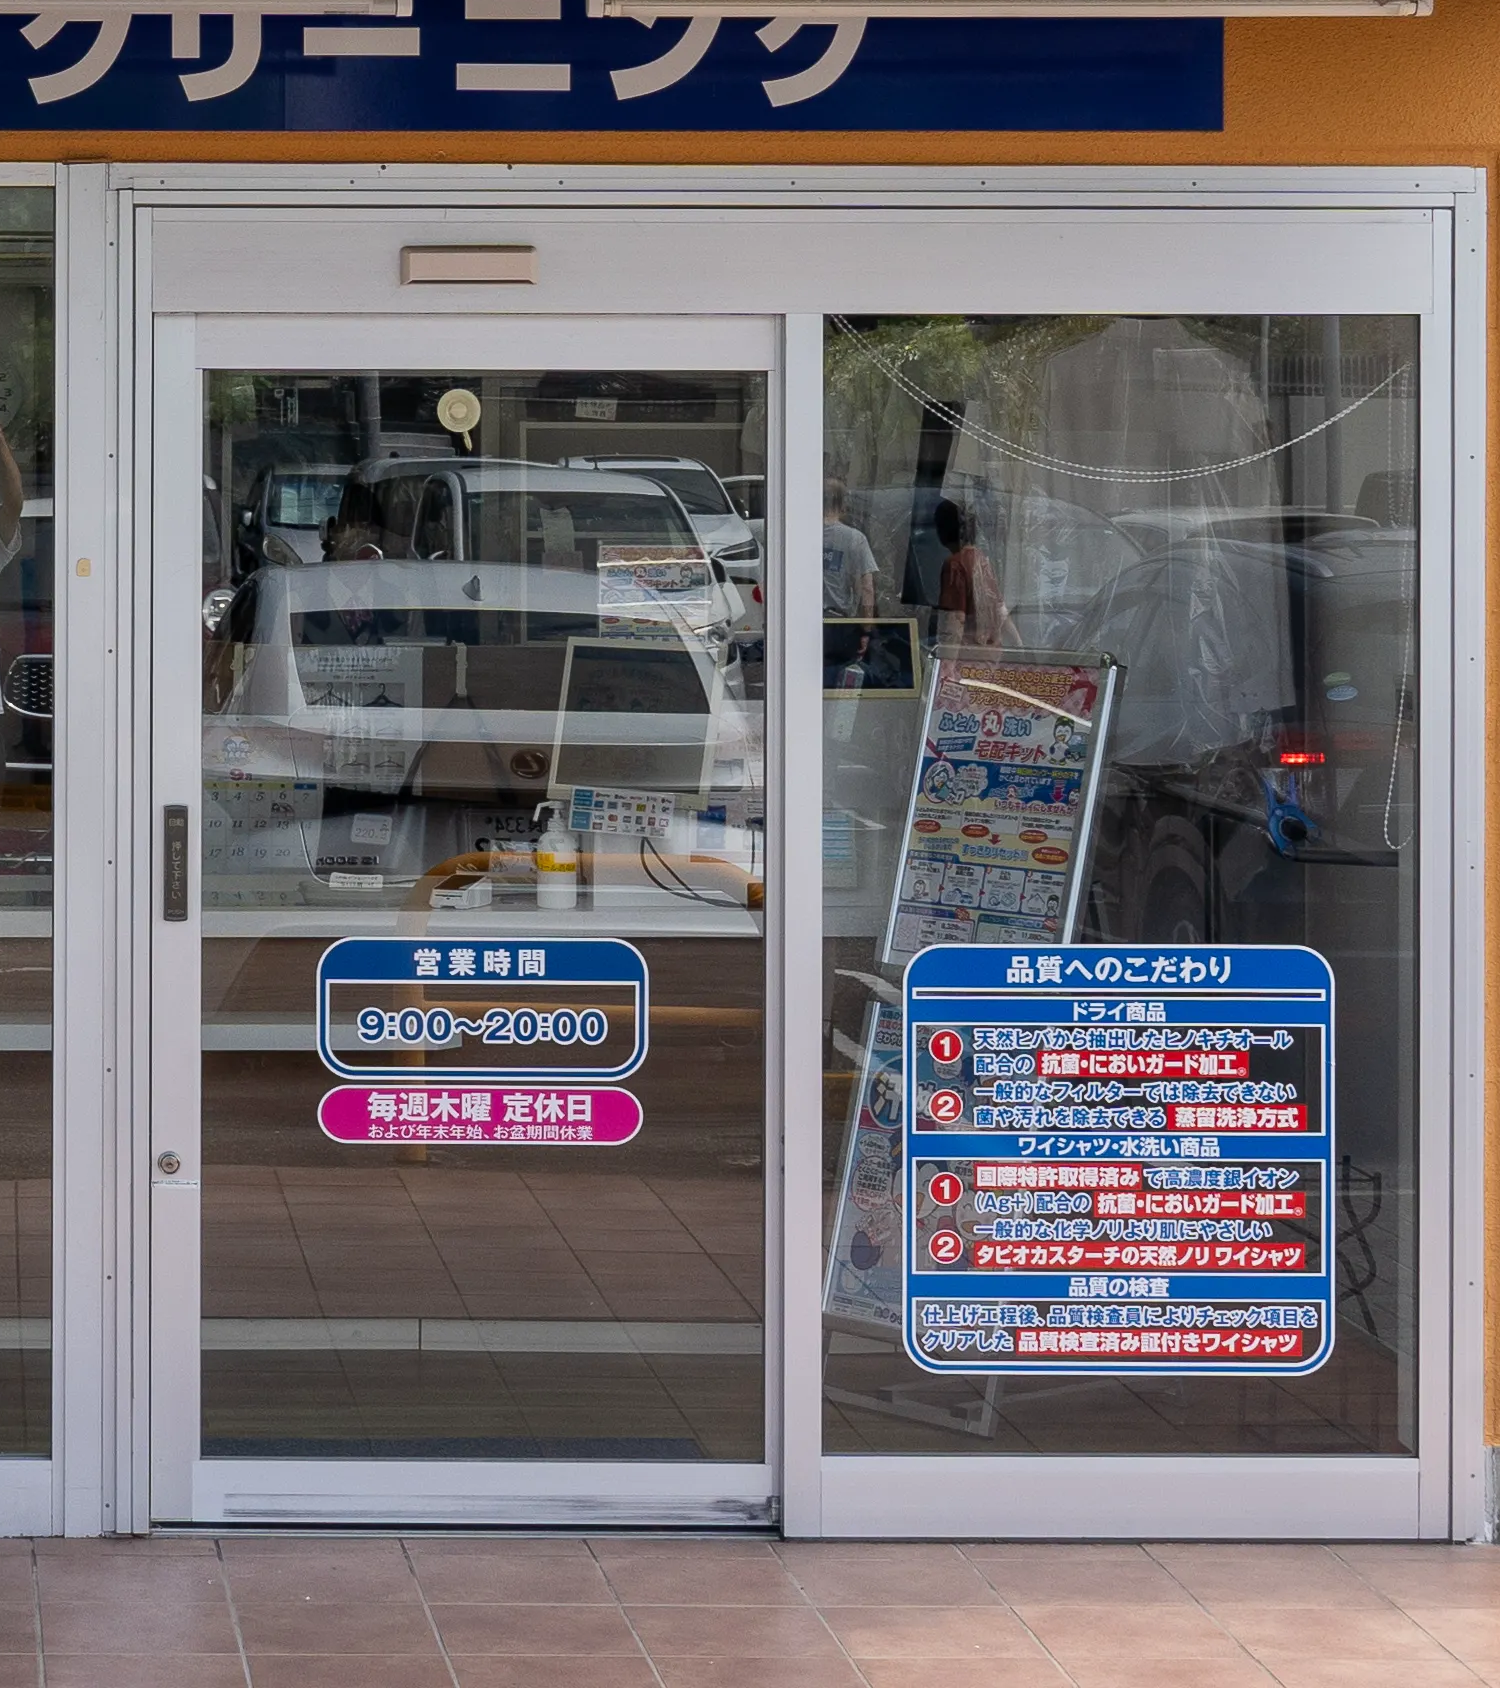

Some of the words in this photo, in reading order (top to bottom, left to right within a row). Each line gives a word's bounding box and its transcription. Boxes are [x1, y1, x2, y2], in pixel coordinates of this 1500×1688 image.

[974, 740, 1047, 762] 宅配キット
[413, 948, 546, 976] 営業時間
[1006, 955, 1232, 984] 品質へのこだわり
[1072, 1001, 1166, 1023] ドライ商品
[974, 1028, 1293, 1051] 天然ヒバから抽出したヒノキチオール
[974, 1054, 1034, 1076] 配合の
[974, 1082, 1297, 1103] 一般的なフィルターでは除去できない
[367, 1092, 492, 1123] 毎週木曜
[502, 1092, 593, 1123] 定休日
[974, 1107, 1165, 1129] 菌や汚れを除去できる
[1175, 1106, 1299, 1129] 蒸留洗浄方式
[368, 1124, 594, 1141] および年末年始、お盆期間休業
[1018, 1137, 1220, 1157] ワイシャツ・水洗い商品
[975, 1166, 1140, 1189] 国際特許取得済み
[1143, 1167, 1299, 1189] で高濃度銀イオン
[974, 1219, 1272, 1240] 一般的な化学ノリより肌にやさしい
[976, 1245, 1210, 1267] タピオカスターチの天然ノリ
[1214, 1246, 1302, 1267] ワイシャツ
[1068, 1277, 1170, 1298] 品質の検査
[922, 1305, 1318, 1328] 仕上げ工程後、品質検査員によりチェック項目を
[922, 1331, 1013, 1352] クリアした
[1018, 1332, 1299, 1355] 品質検査済み証付きワイシャツ
